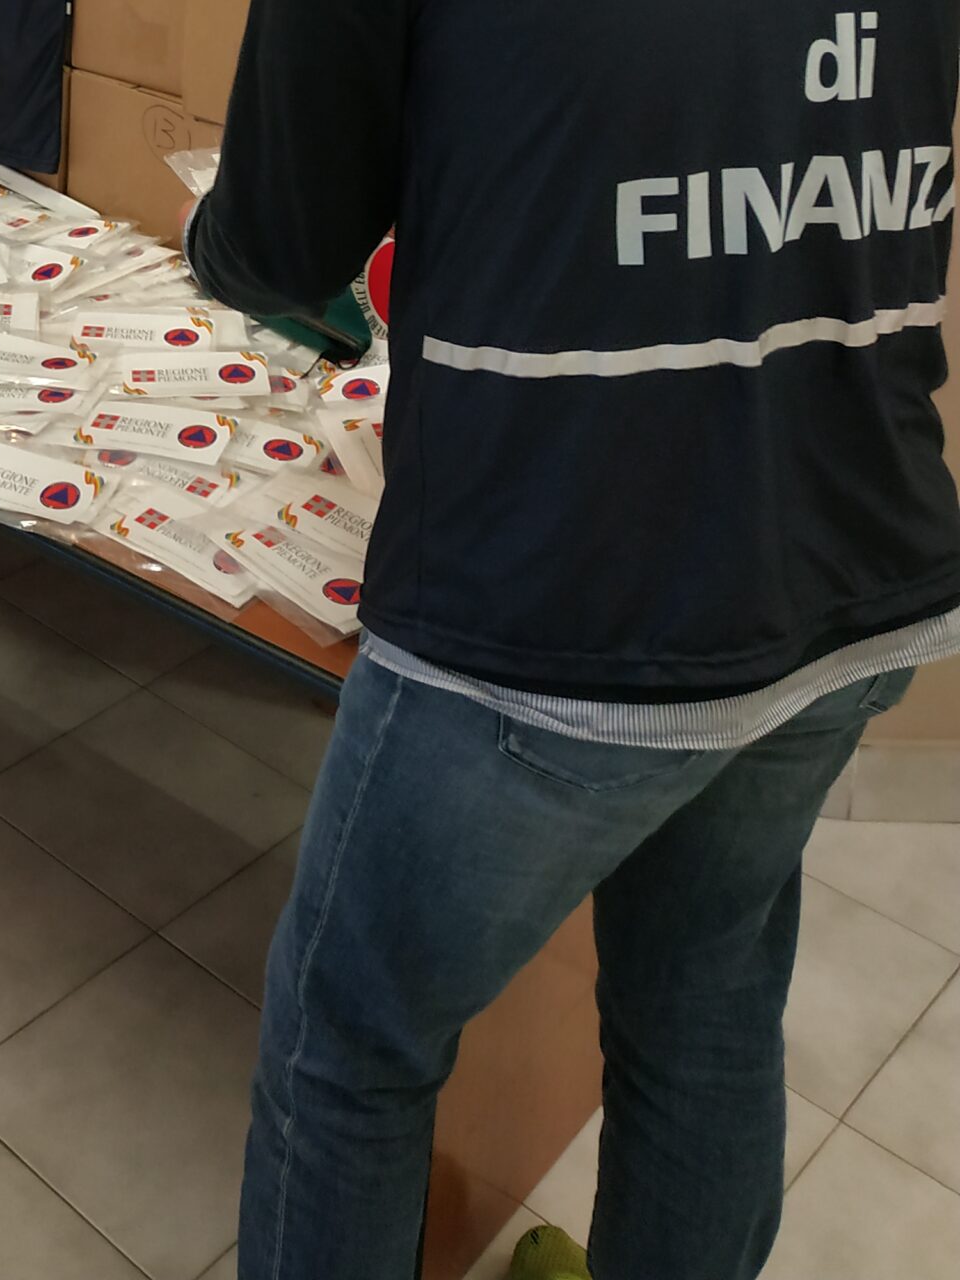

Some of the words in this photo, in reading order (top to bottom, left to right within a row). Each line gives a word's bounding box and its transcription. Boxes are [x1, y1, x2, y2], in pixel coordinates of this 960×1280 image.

[804, 11, 878, 103] di
[106, 326, 154, 336] REGIONE
[157, 368, 208, 376] REGIONE
[120, 416, 174, 431] REGIONE
[333, 506, 373, 530] REGIO
[282, 542, 333, 574] REGIONE
